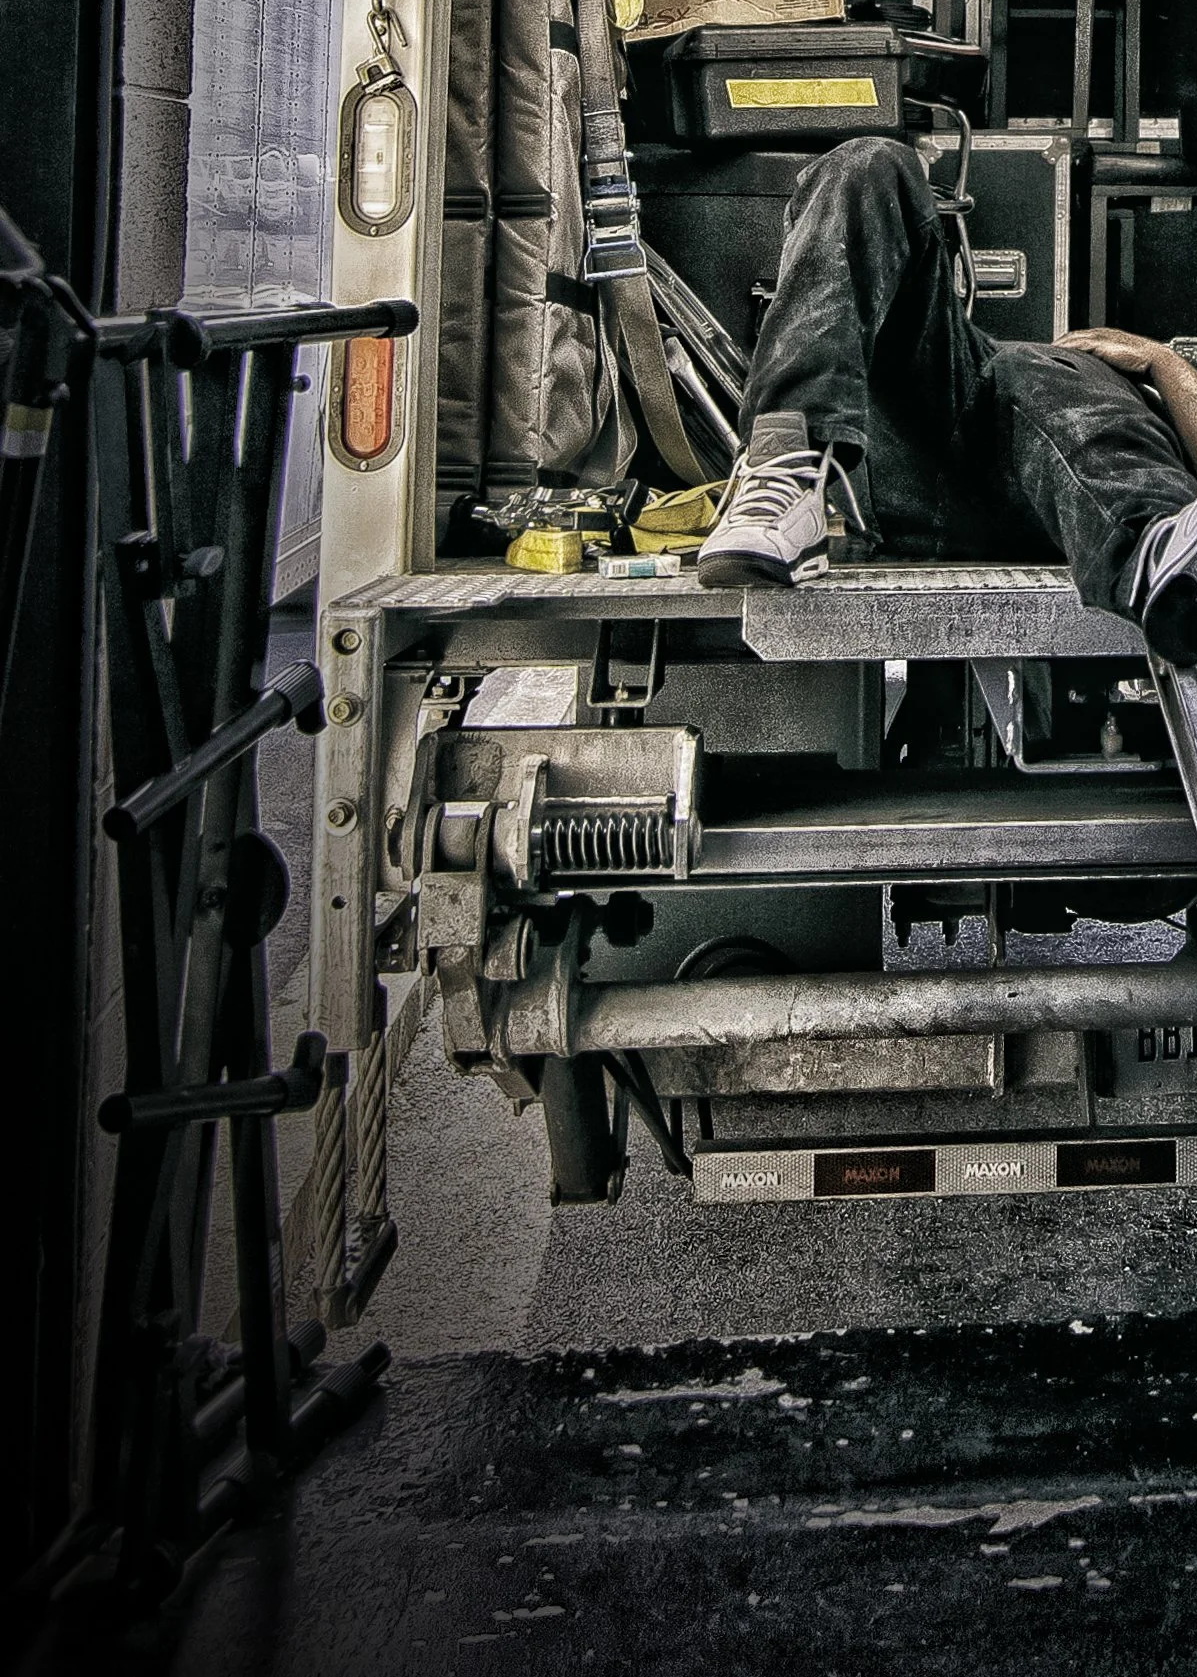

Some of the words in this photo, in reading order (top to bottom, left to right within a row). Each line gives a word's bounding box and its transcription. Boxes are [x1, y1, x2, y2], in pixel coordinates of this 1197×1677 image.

[721, 1171, 780, 1189] MAXON
[843, 1165, 901, 1184] MAXON
[965, 1160, 1024, 1179] MAXON
[1085, 1156, 1141, 1175] MAXON
